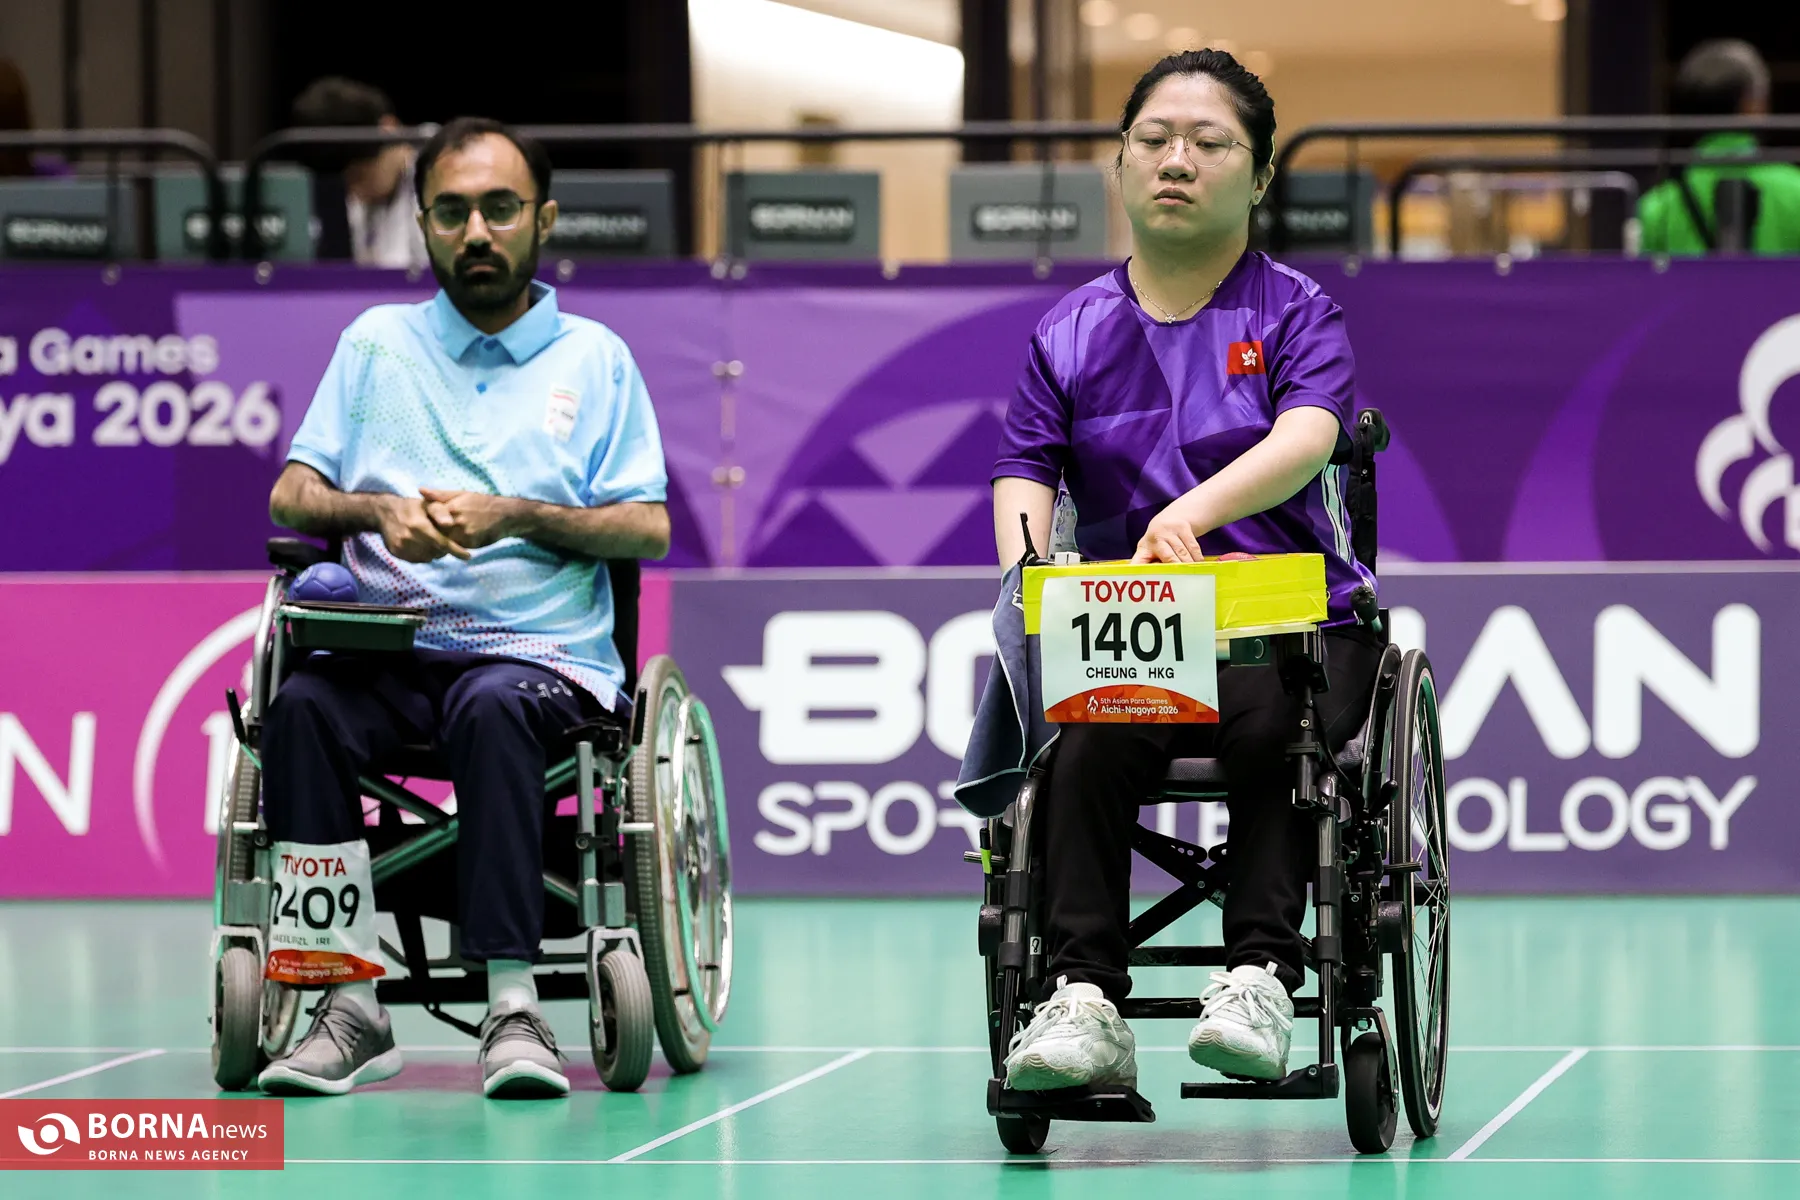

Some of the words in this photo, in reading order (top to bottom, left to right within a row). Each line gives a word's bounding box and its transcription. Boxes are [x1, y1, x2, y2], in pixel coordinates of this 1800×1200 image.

[29, 327, 219, 375] Games
[0, 392, 75, 463] ya
[92, 381, 281, 447] 2026
[1081, 580, 1176, 603] TOYOTA
[1071, 612, 1184, 662] 1401
[1086, 667, 1137, 679] CHEUNG
[1148, 667, 1175, 679] HKG
[1100, 697, 1112, 705] 5th
[1112, 697, 1130, 705] Asian
[1131, 697, 1146, 705] Para
[1146, 697, 1169, 705] Games
[1101, 705, 1156, 716] Aichi-Nagoya
[1158, 705, 1179, 714] 2026
[281, 855, 346, 877] TYOTA
